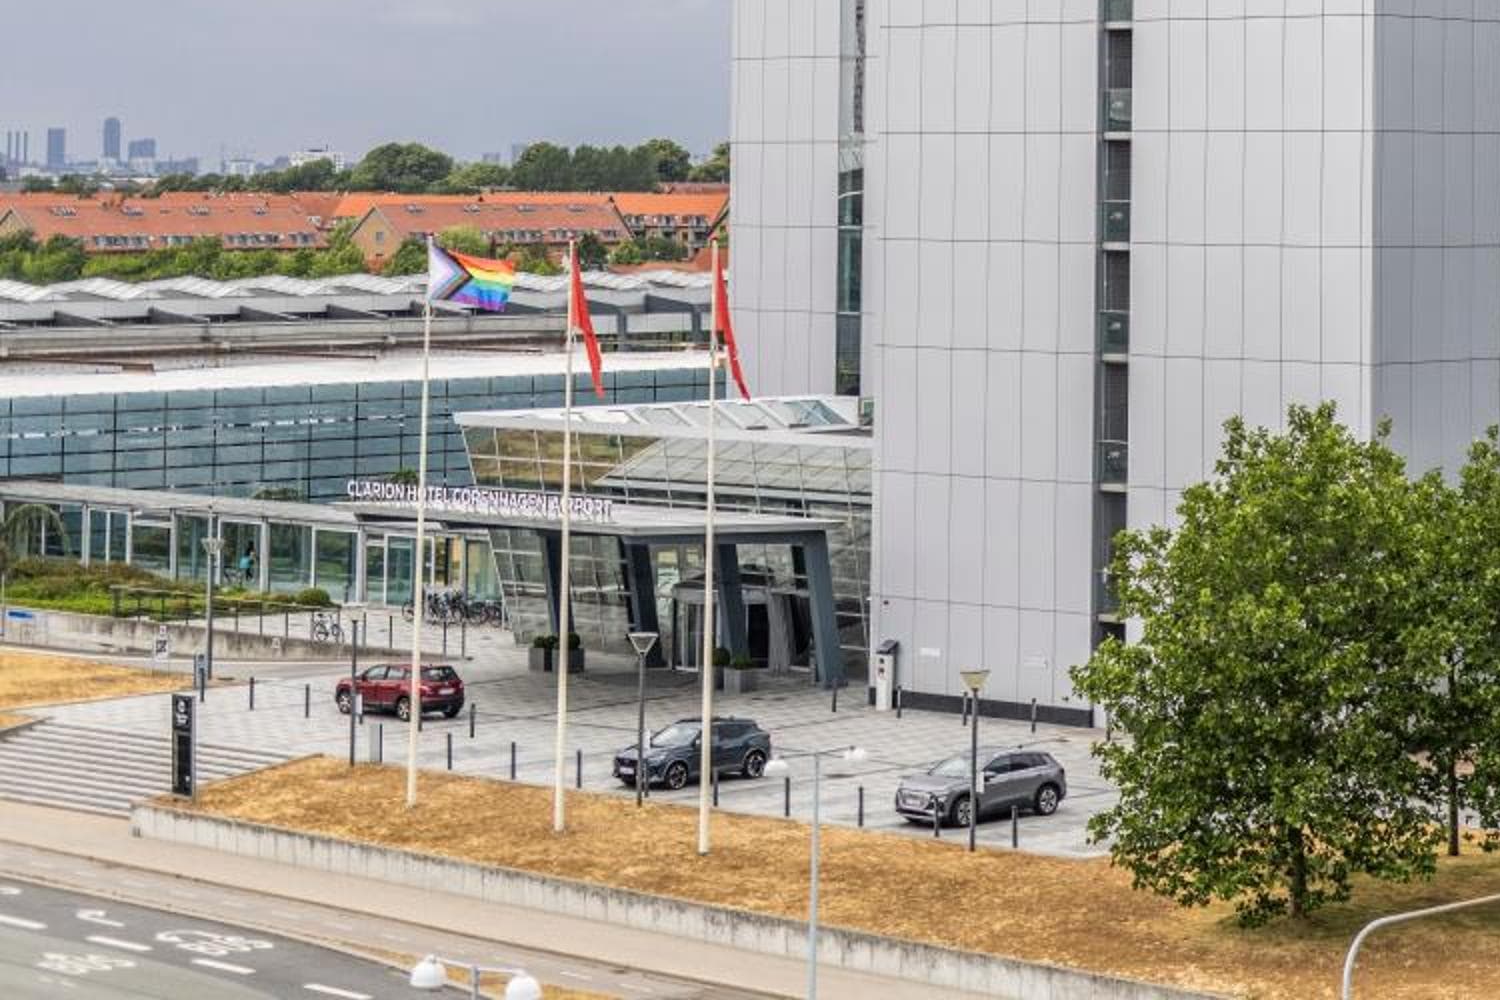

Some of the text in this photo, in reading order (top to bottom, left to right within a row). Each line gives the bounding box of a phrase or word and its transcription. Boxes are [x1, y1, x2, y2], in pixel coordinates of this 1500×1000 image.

[347, 479, 405, 499] CLARION
[451, 486, 546, 510] COPENHAGEN
[549, 494, 613, 517] ARPORT
